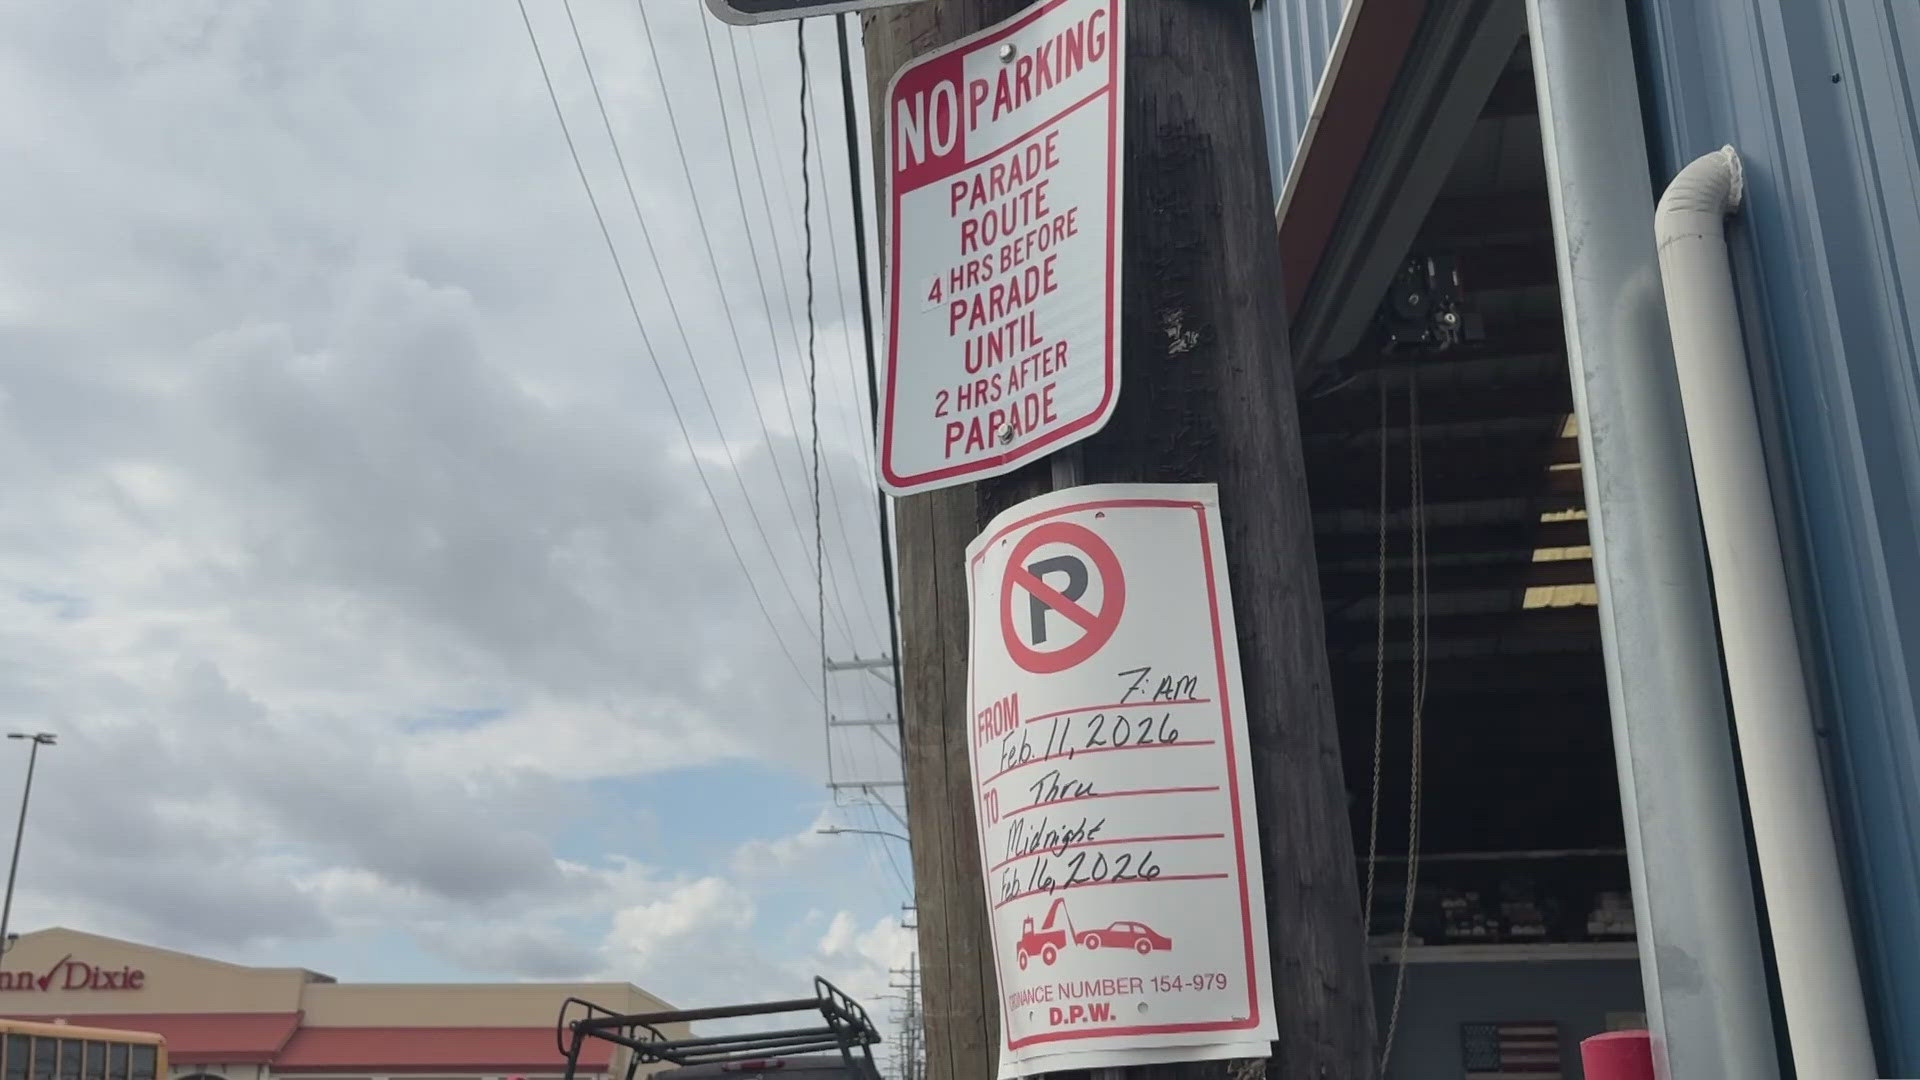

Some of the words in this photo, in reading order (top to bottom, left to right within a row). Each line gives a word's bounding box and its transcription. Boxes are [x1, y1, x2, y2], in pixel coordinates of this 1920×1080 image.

[898, 79, 958, 172] NO
[969, 9, 1105, 131] PARKING
[951, 129, 1059, 218] PARADE
[961, 179, 1049, 256] ROUTE
[928, 277, 942, 303] 4
[951, 254, 993, 294] HRS
[1000, 206, 1078, 273] BEFORE
[950, 253, 1058, 336] PARADE
[965, 310, 1043, 374] UNTIL
[935, 390, 949, 418] 2
[957, 373, 1001, 412] HRS
[1007, 340, 1068, 396] AFTER
[945, 382, 1058, 459] PARADE
[977, 692, 1019, 748] FROM
[1000, 729, 1035, 774] Feb.
[1044, 716, 1075, 761] 11,
[1086, 713, 1179, 748] 2026
[983, 788, 999, 828] TO
[1029, 769, 1099, 805] Thru
[1006, 816, 1105, 861] Midnight
[1064, 851, 1161, 890] 2026
[61, 961, 145, 990] Dixie
[1009, 985, 1053, 1011] NANCE
[1058, 977, 1144, 1000] NUMBER
[1150, 973, 1228, 993] 154-979
[1049, 1002, 1117, 1026] D.P.W.
